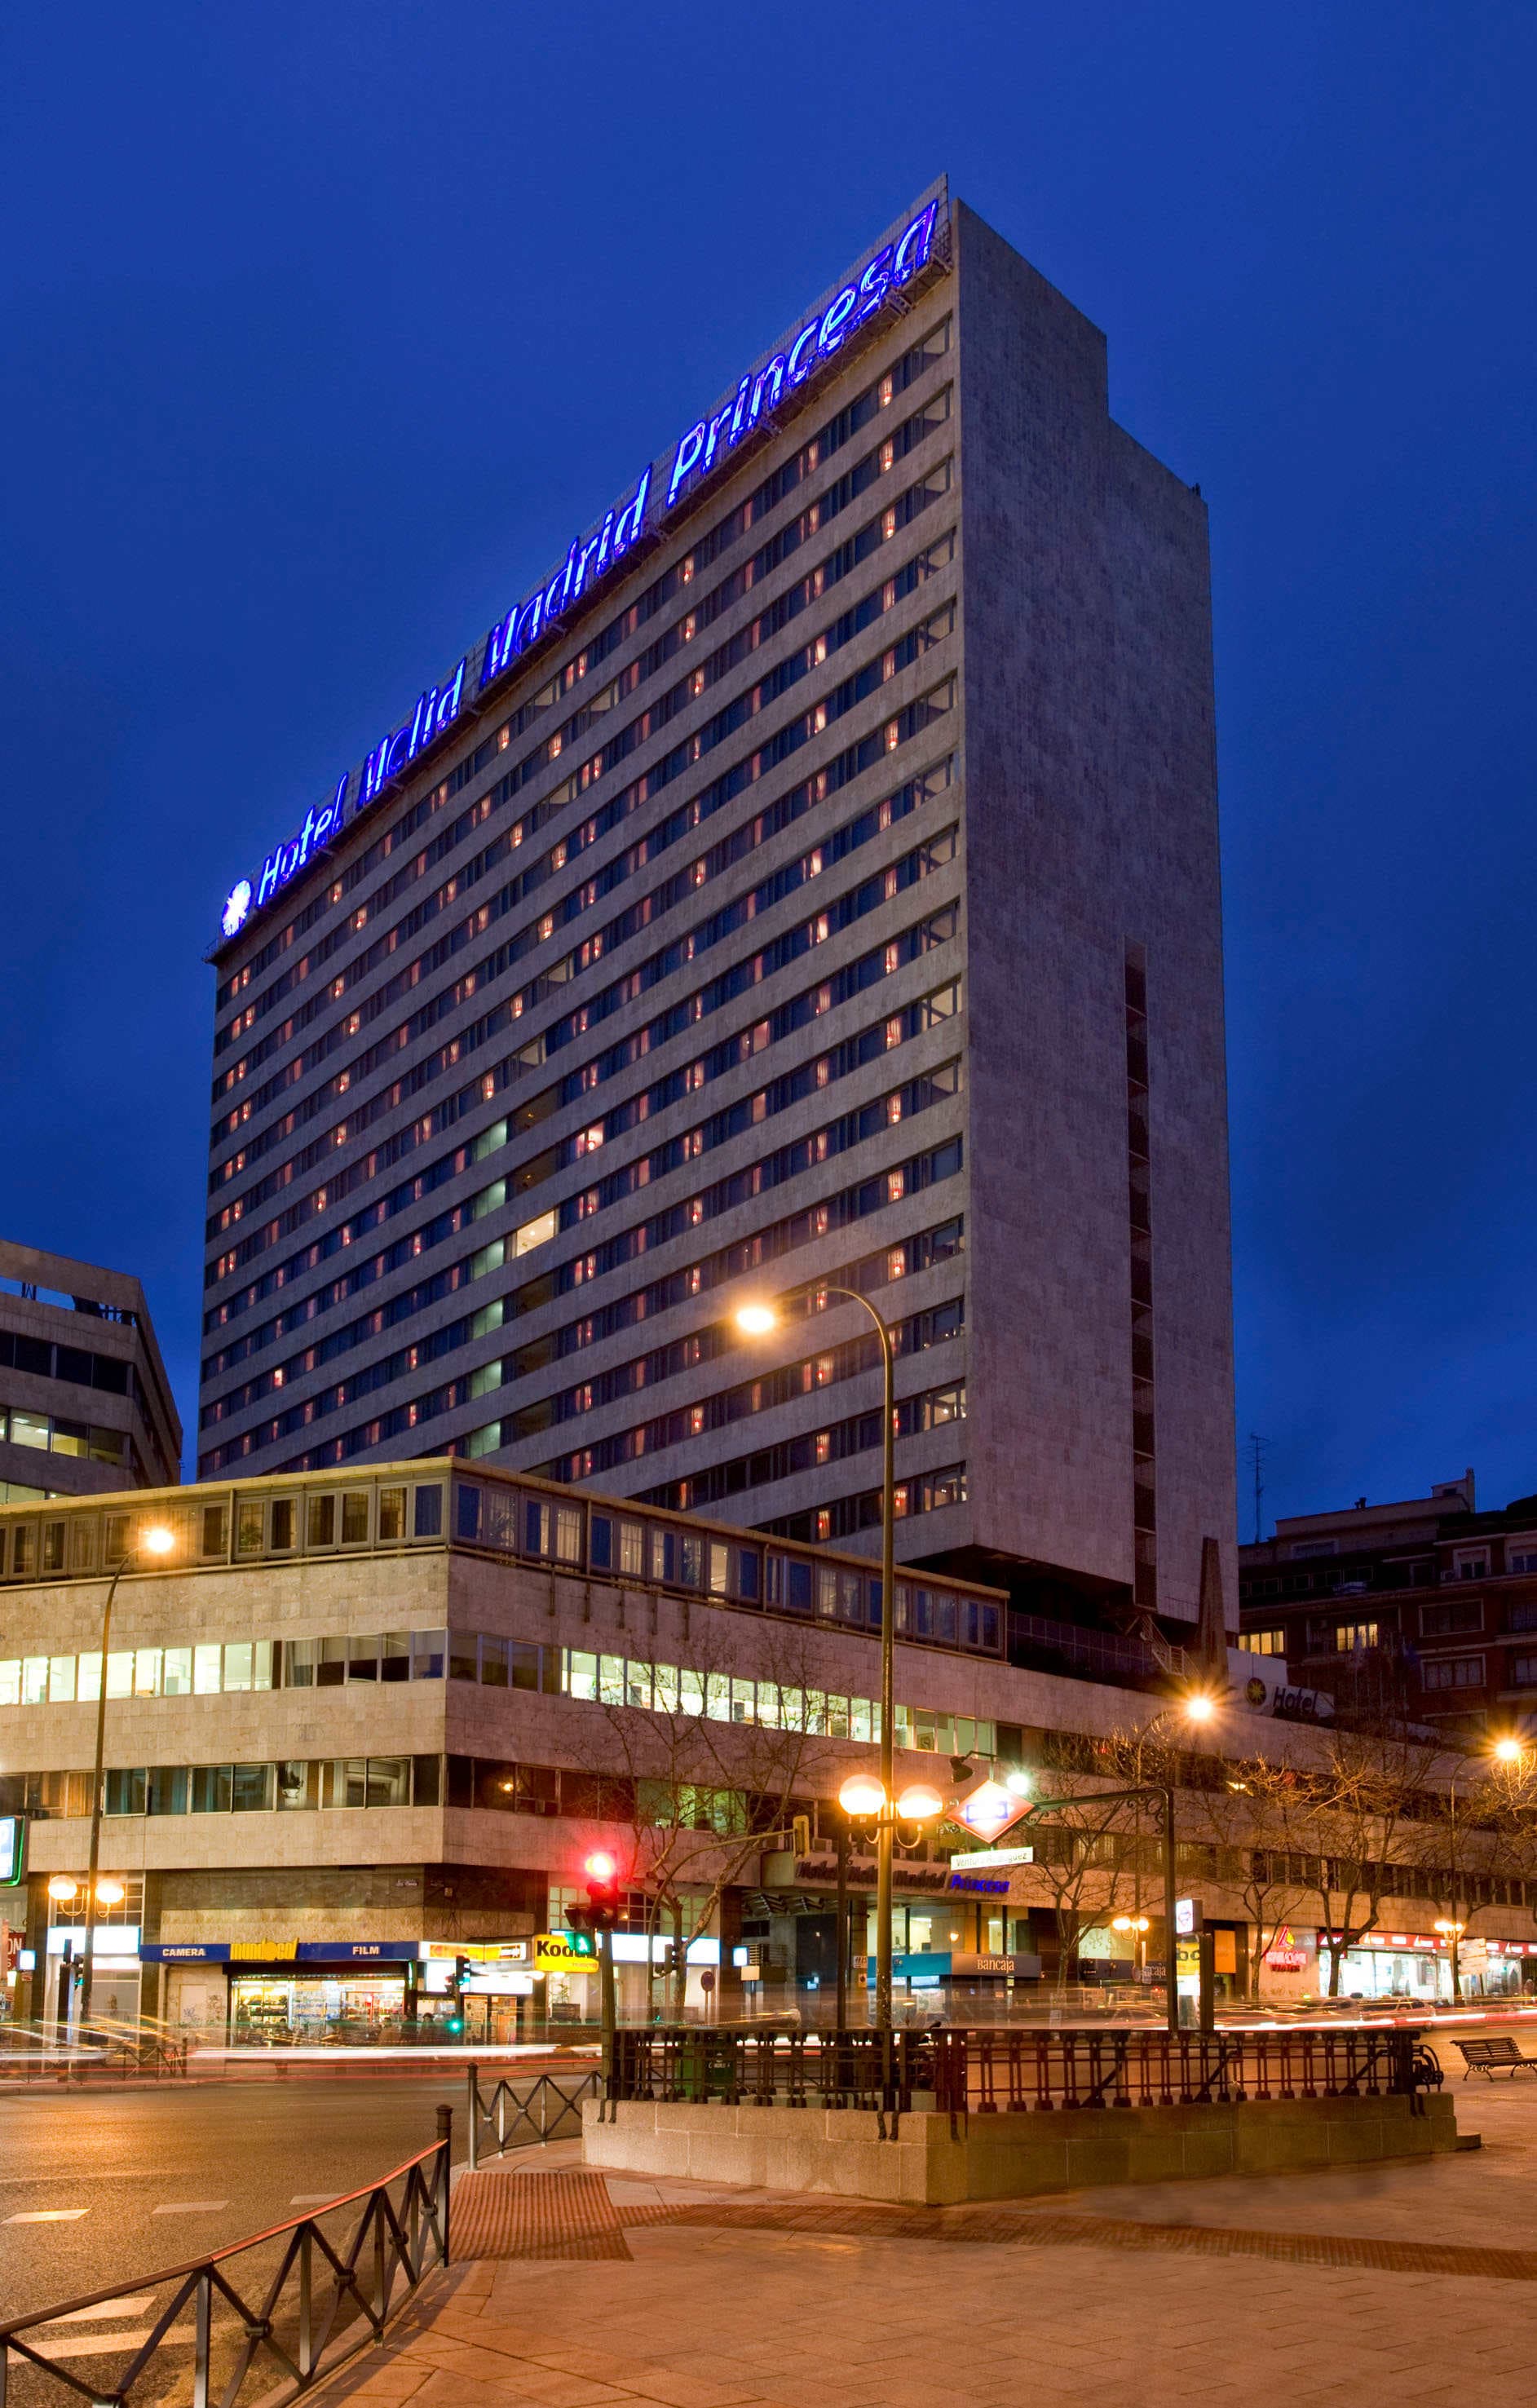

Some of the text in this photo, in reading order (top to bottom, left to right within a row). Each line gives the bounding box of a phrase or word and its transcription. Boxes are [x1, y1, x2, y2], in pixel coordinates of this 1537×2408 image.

[256, 771, 349, 908] Hotel
[479, 462, 654, 690] Madrid
[665, 198, 939, 507] Princesa
[1273, 1686, 1318, 1712] Hotel
[950, 1874, 1010, 1894] Princesa
[162, 1947, 205, 1957] CAMERA
[351, 1945, 380, 1955] FILM
[537, 1940, 597, 1958] Kod
[977, 1955, 1015, 1973] Bancaja
